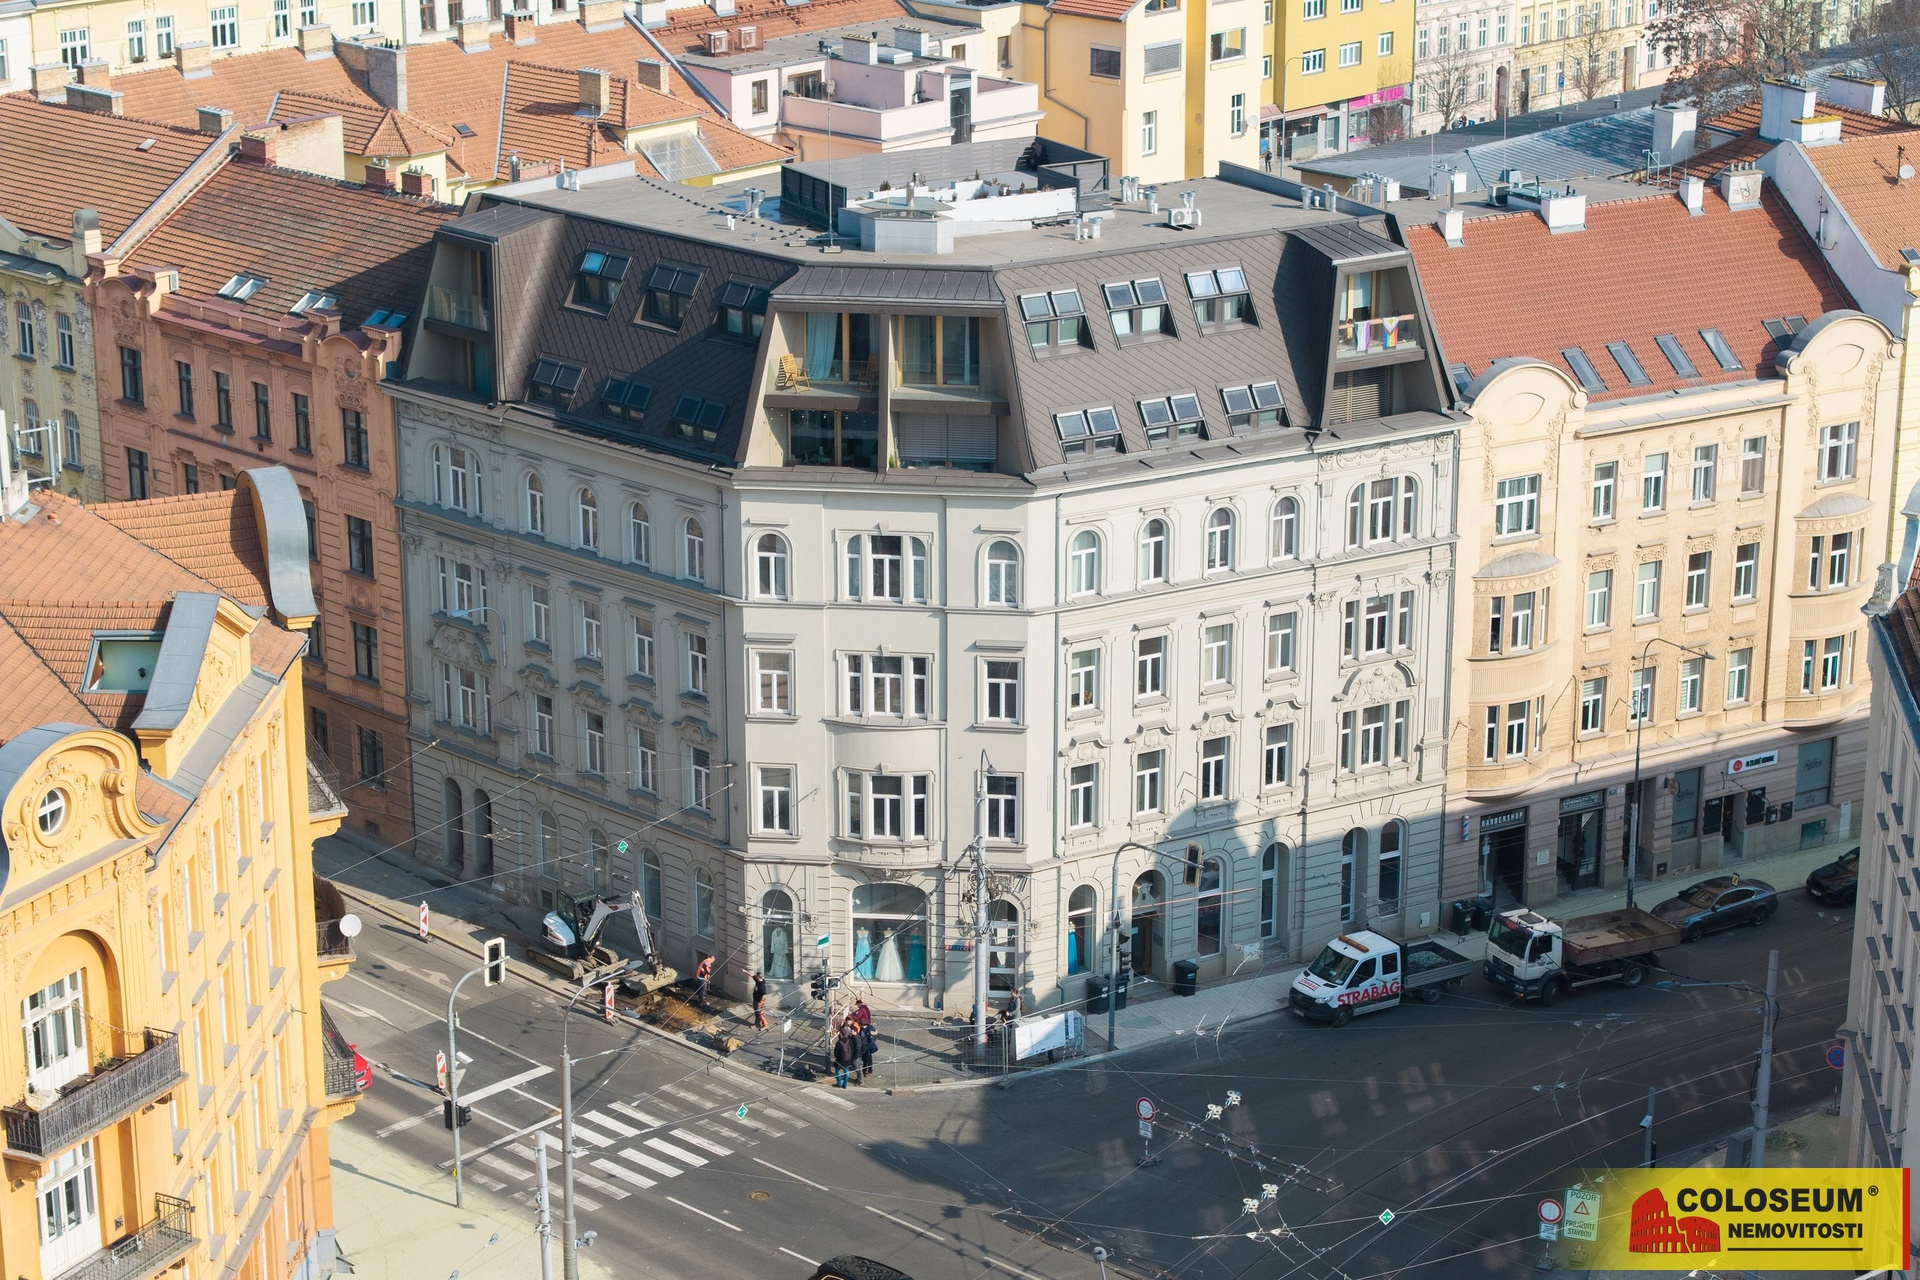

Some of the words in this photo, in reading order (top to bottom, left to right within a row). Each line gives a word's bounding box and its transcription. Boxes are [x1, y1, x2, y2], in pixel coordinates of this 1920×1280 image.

[1481, 811, 1523, 827] BARBERSHOP
[1337, 981, 1400, 1006] STRABAG
[1570, 1191, 1597, 1201] POZOR
[1567, 1228, 1592, 1238] STAVBOU
